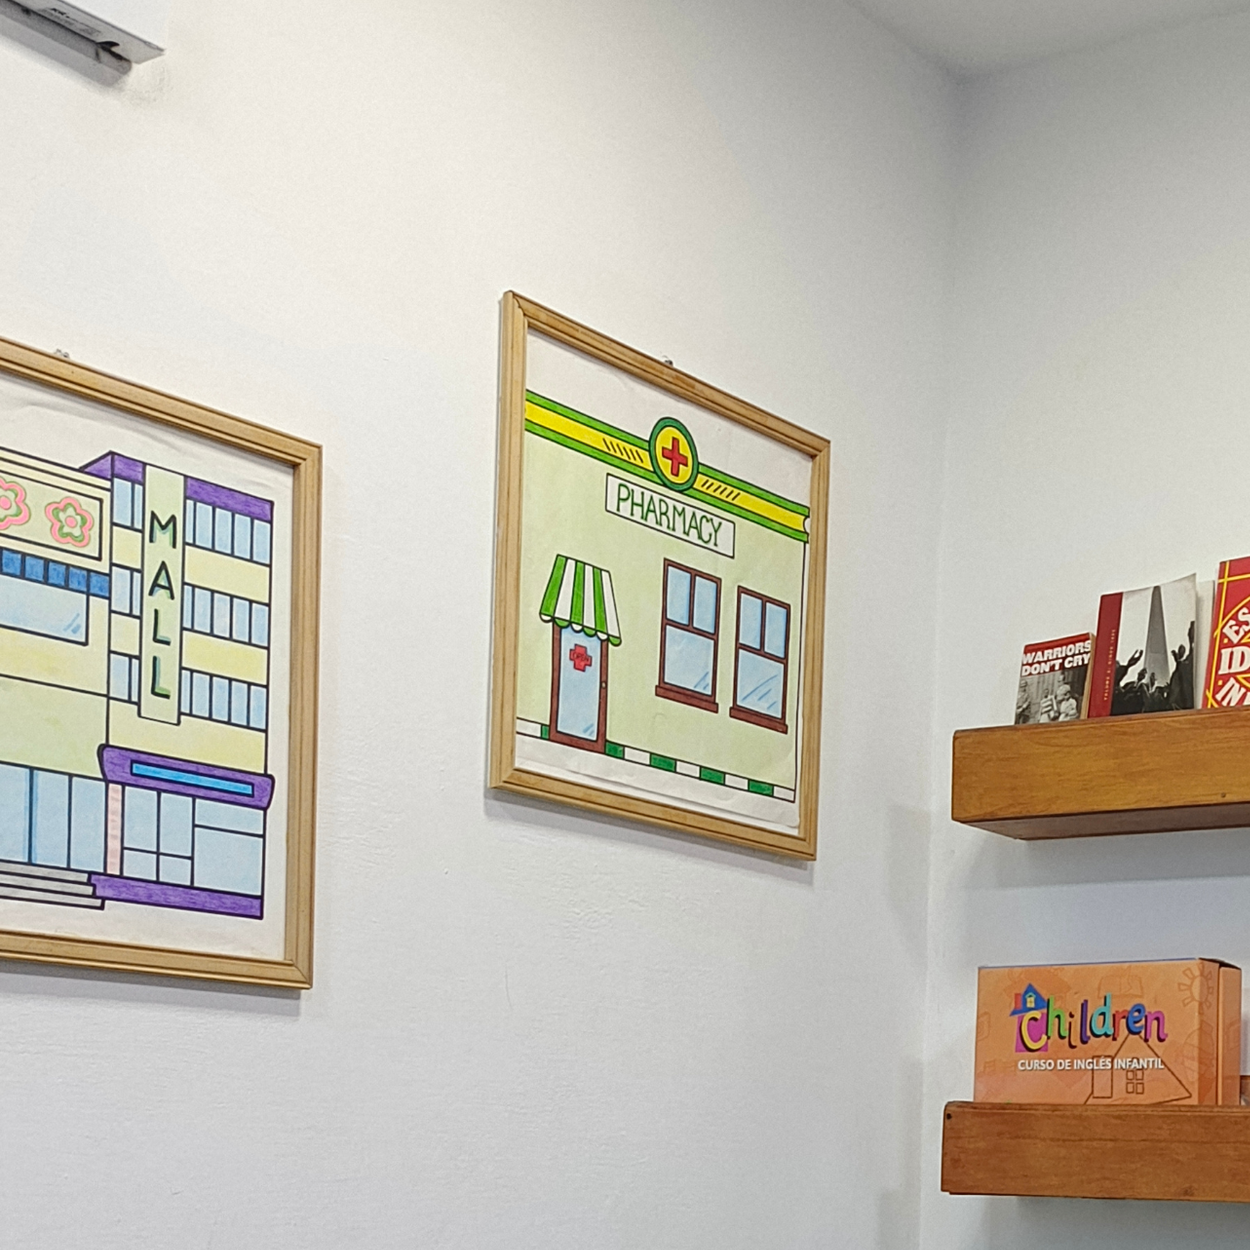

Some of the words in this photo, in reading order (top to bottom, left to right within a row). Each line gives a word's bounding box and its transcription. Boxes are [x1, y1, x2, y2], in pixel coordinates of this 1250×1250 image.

[616, 482, 723, 547] PHARMACY
[148, 510, 177, 700] MALL
[1021, 659, 1063, 676] DON'T
[1064, 653, 1092, 668] CRY
[1022, 640, 1092, 665] WARRIORS
[1215, 676, 1246, 706] IN
[1019, 991, 1169, 1052] Children
[1017, 1059, 1055, 1070] CURSO
[1056, 1059, 1072, 1070] DE
[1073, 1055, 1112, 1070] INGLÉS
[1114, 1057, 1165, 1069] INFANTIL
